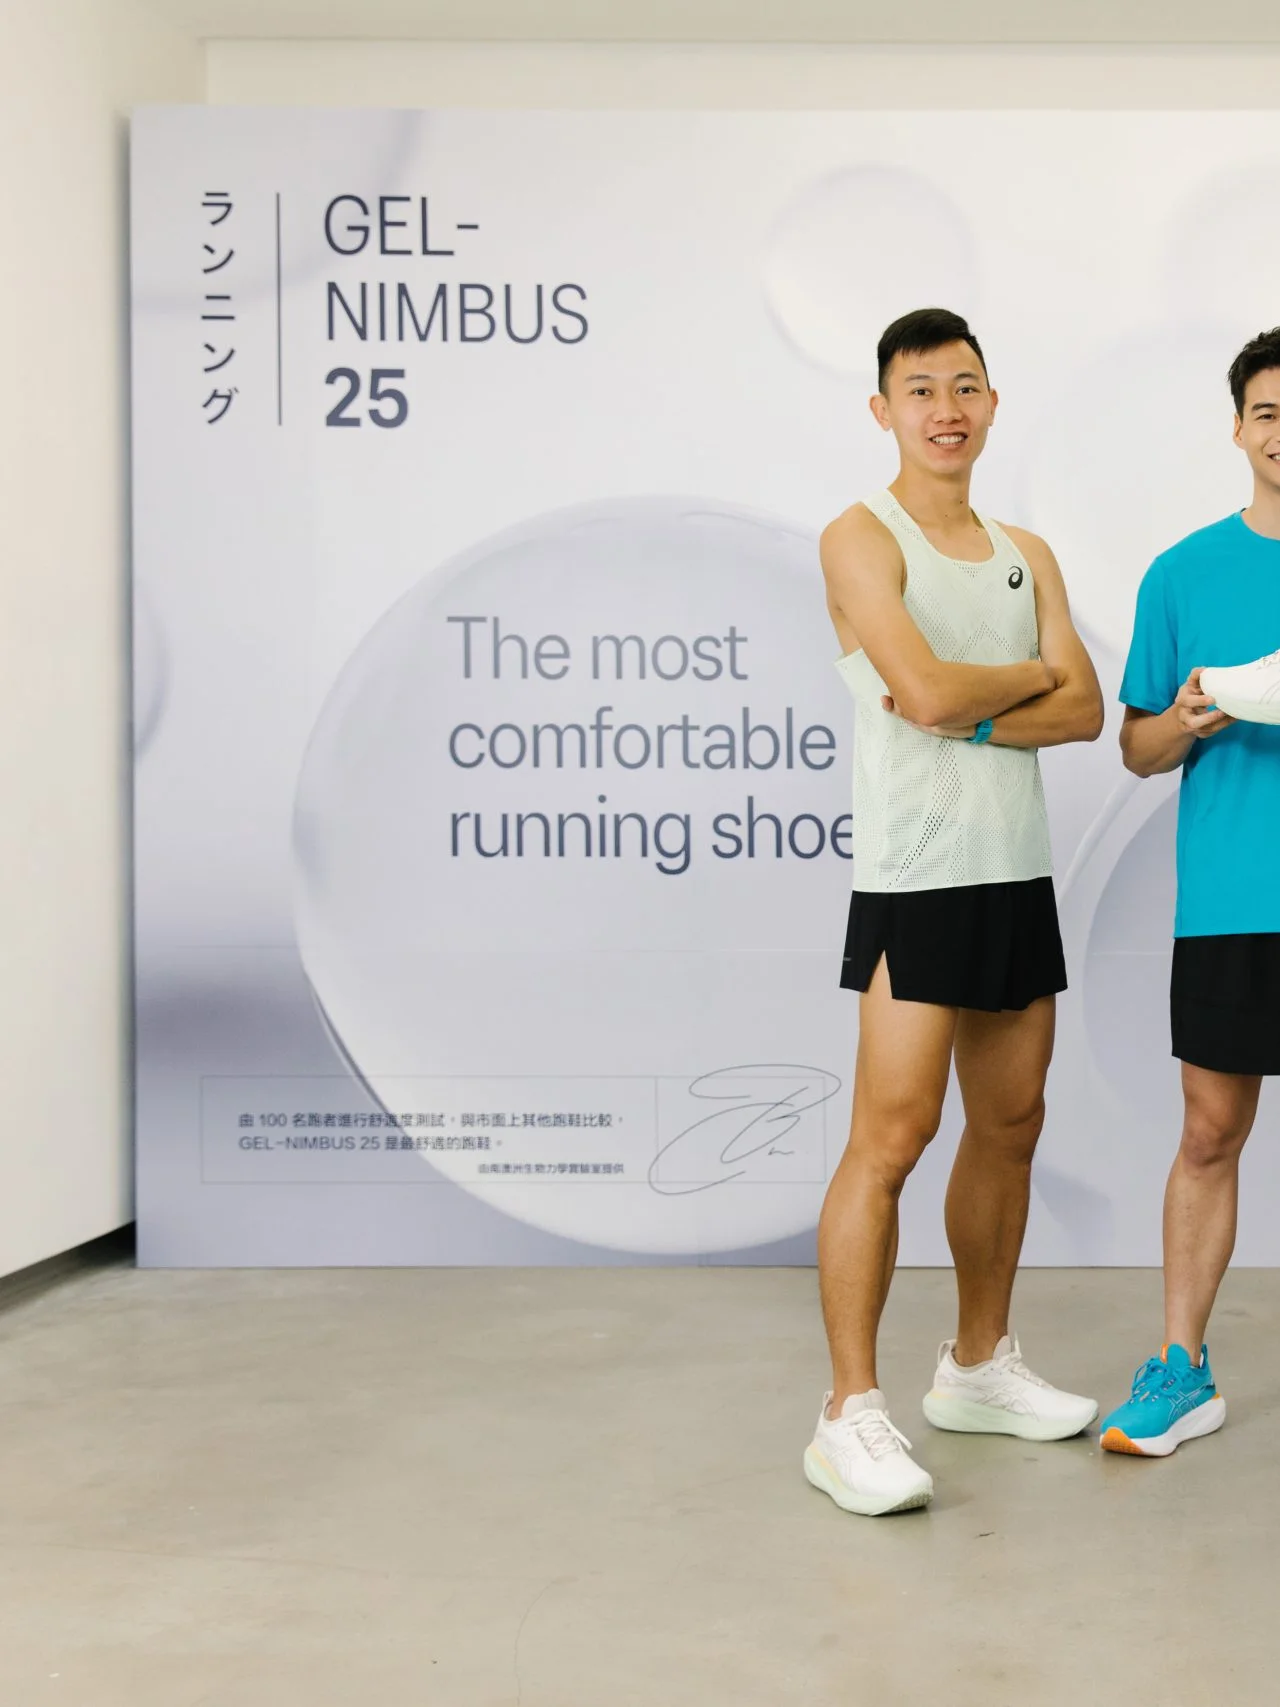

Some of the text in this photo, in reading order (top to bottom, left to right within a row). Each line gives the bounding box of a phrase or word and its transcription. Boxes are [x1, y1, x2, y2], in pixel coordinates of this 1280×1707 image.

[324, 195, 479, 256] GEL-
[201, 192, 238, 424] ランニング
[327, 282, 588, 344] NIMBUS
[324, 366, 409, 429] 25
[447, 616, 749, 682] The most
[448, 705, 837, 771] comfortable
[450, 793, 853, 876] running shoe
[238, 1136, 356, 1150] GEL-NIMBUS
[360, 1136, 380, 1150] 25
[259, 1113, 288, 1127] 100
